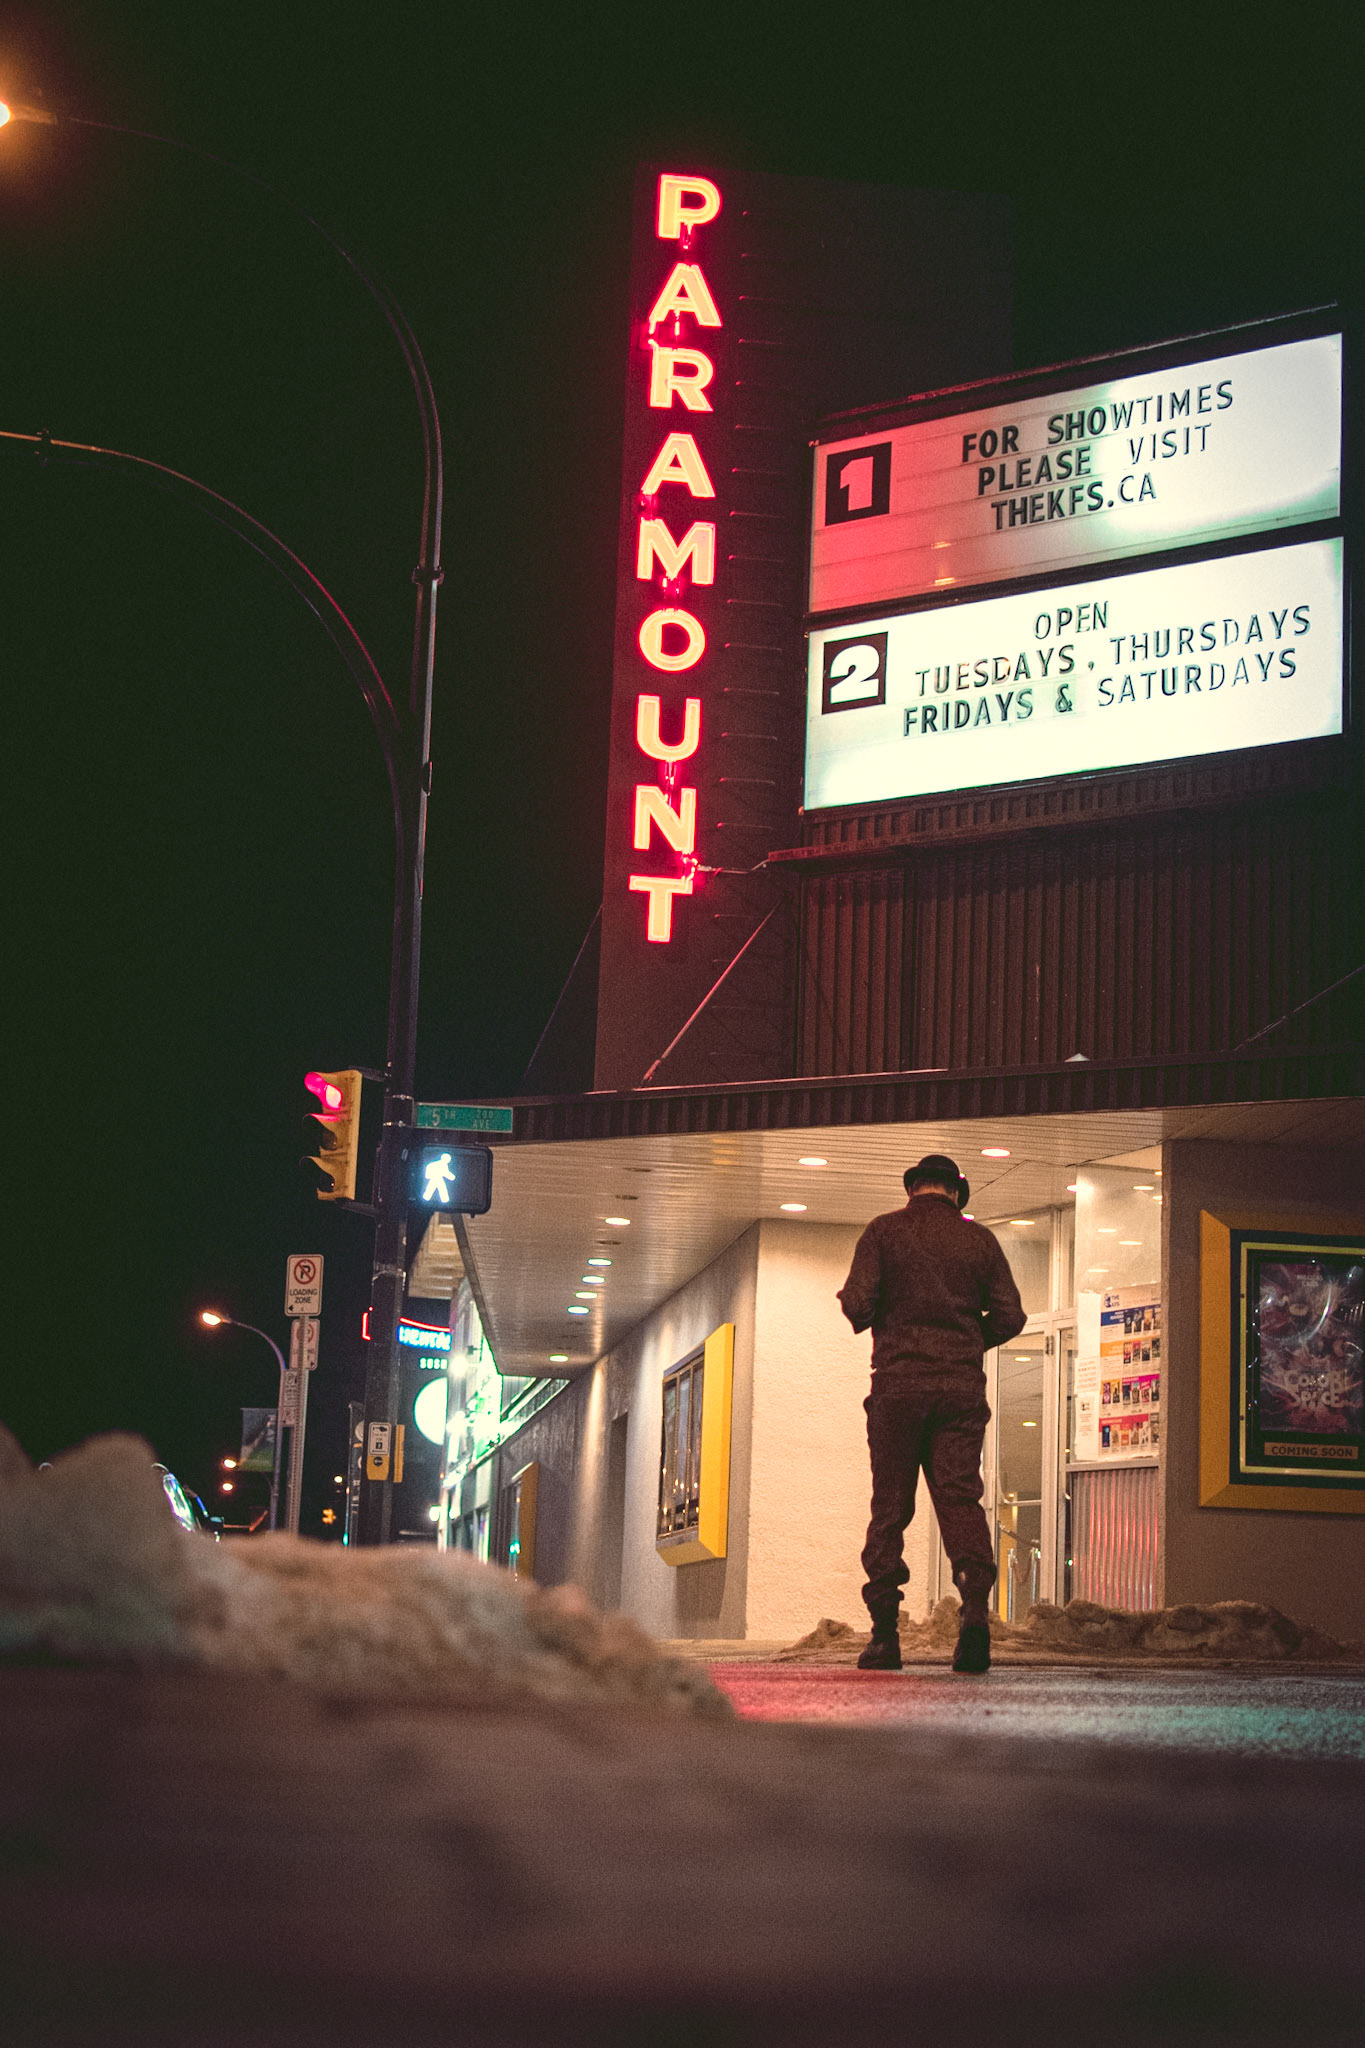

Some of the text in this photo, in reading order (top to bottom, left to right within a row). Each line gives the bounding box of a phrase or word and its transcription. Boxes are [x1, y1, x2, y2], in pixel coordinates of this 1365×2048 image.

[962, 380, 1234, 463] FOR SHOWTIMES
[839, 455, 875, 511] 1
[977, 423, 1213, 496] PLEASE VISIT
[991, 474, 1157, 531] THEKFS.CA
[629, 173, 723, 943] PARAMOUNT
[1034, 601, 1109, 640] OPEN
[1109, 604, 1312, 666] THURSDAYS
[829, 644, 881, 704] 2
[903, 648, 1297, 737] FRIDAYS & SATURDAYS
[472, 1119, 491, 1129] AVE
[289, 1289, 318, 1297] LOADING
[294, 1296, 313, 1304] ZONE
[1271, 1446, 1353, 1457] COMING SOON
